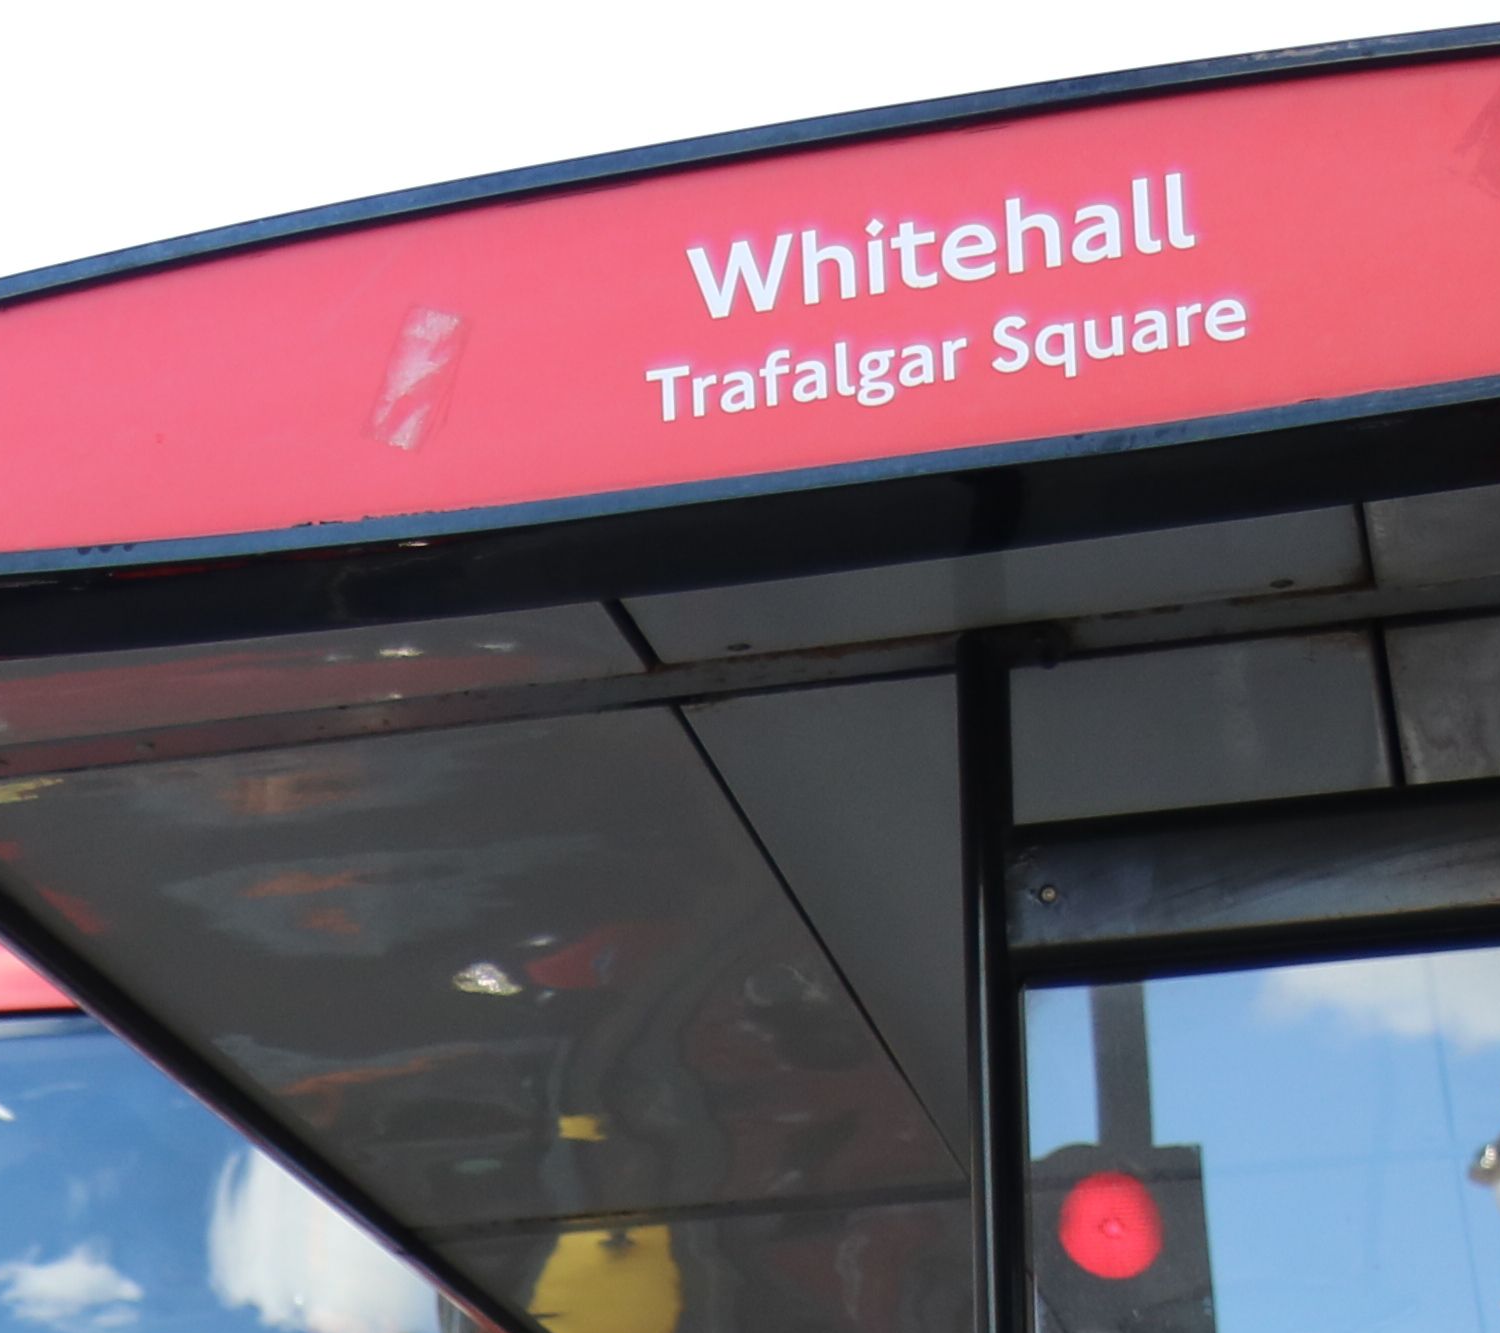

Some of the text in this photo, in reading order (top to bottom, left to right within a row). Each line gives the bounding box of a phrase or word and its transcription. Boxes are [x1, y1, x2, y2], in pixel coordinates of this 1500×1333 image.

[686, 172, 1195, 320] Whitehall
[646, 298, 1248, 422] Trafalgar Square
